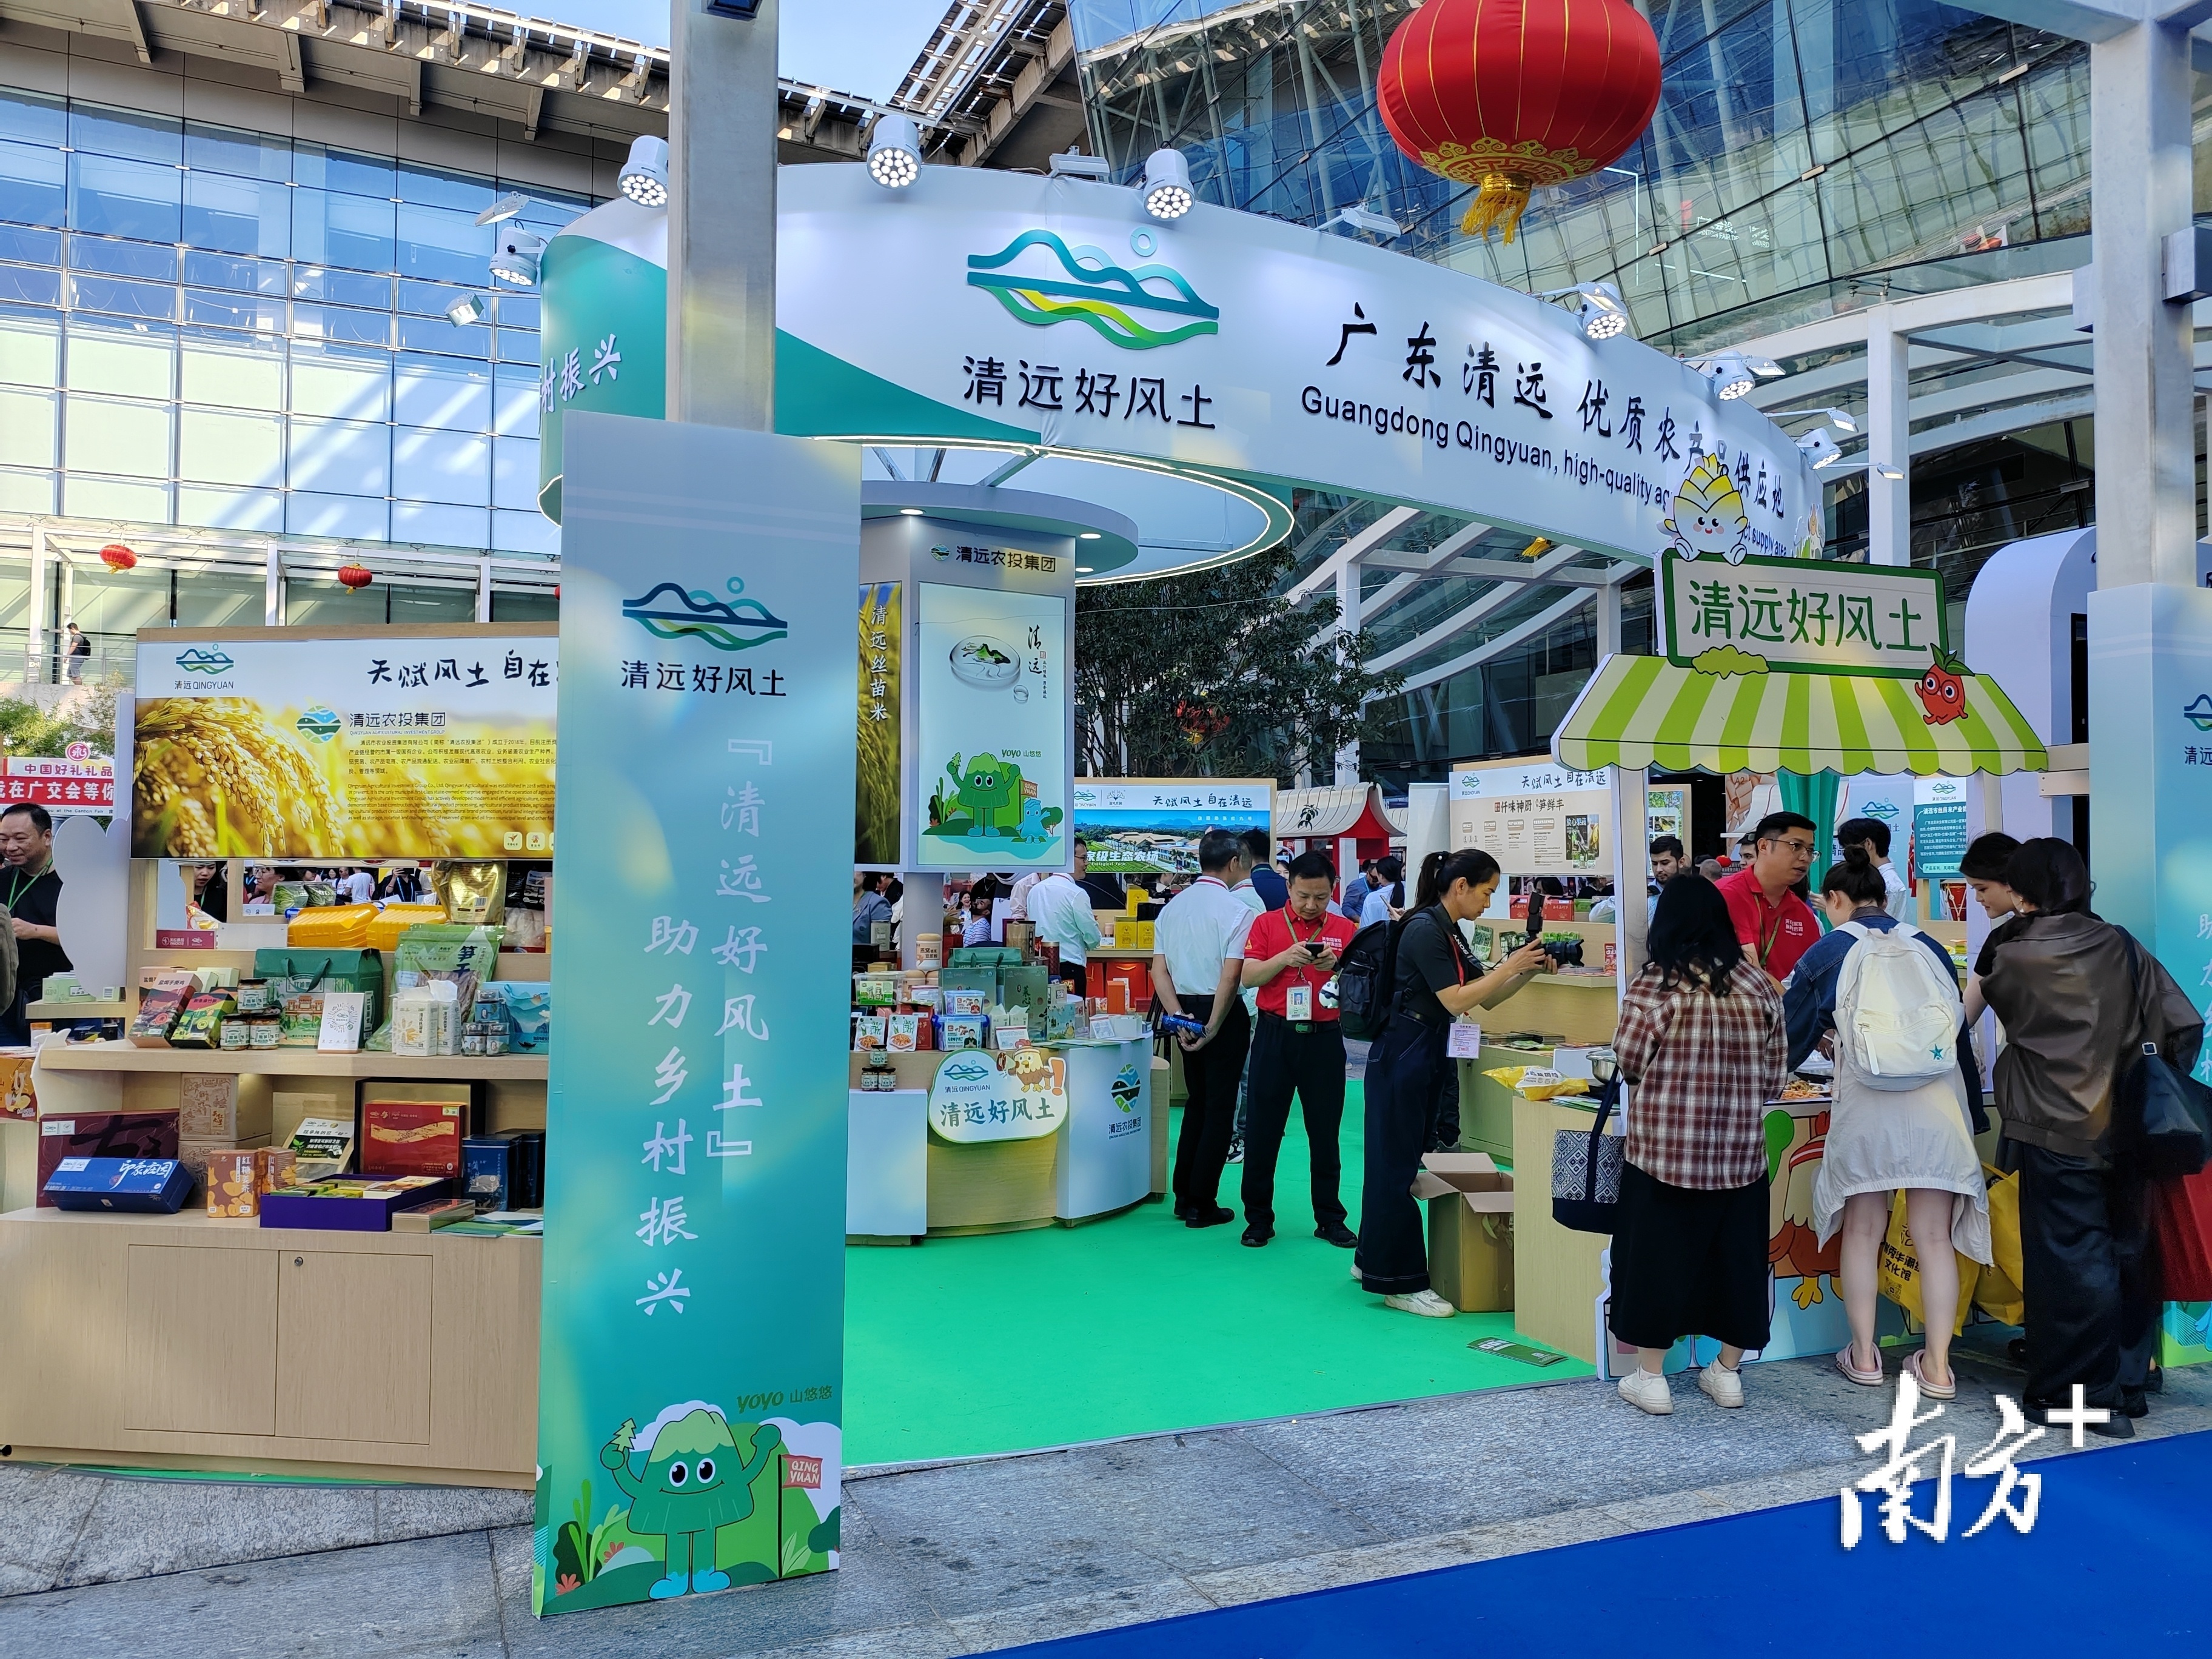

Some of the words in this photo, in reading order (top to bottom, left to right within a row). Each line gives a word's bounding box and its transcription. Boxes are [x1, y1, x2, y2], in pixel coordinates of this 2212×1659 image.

[962, 355, 1216, 429] 清远好风土
[1326, 302, 1553, 419] 广东清远
[1577, 378, 1785, 518] 优质农产品供应地
[1302, 386, 1449, 449] Guangdong
[1456, 420, 1558, 475] Qingyuan,
[1564, 449, 1652, 506] high-quality
[1751, 529, 1774, 557] supply
[1775, 539, 1787, 557] area
[956, 545, 1056, 573] 清远农投集团
[1688, 580, 1928, 652] 清远好风土
[367, 659, 489, 688] 天赋风土
[504, 649, 558, 688] 自在
[869, 605, 888, 723] 清远丝苗米
[175, 680, 192, 689] 清远
[193, 681, 234, 689] QINGYUAN
[621, 660, 787, 697] 清远好风土
[349, 712, 446, 728] 清远农投集团
[25, 763, 113, 777] 中国好礼礼品
[1521, 774, 1563, 790] 天赋风土
[1152, 795, 1202, 808] 天赋风土
[1208, 793, 1253, 808] 自在清远
[1501, 799, 1532, 813] 仟味神厨
[706, 739, 773, 1157] 『清远好风土』
[635, 916, 700, 1316] 助力乡村振兴
[940, 1097, 1055, 1127] 清远好风土
[1108, 1116, 1141, 1134] 清远农投集团
[1885, 1258, 1912, 1281] 文化馆
[789, 1385, 833, 1404] 山悠悠
[789, 1470, 820, 1484] YUAN
[791, 1460, 819, 1474] QING
